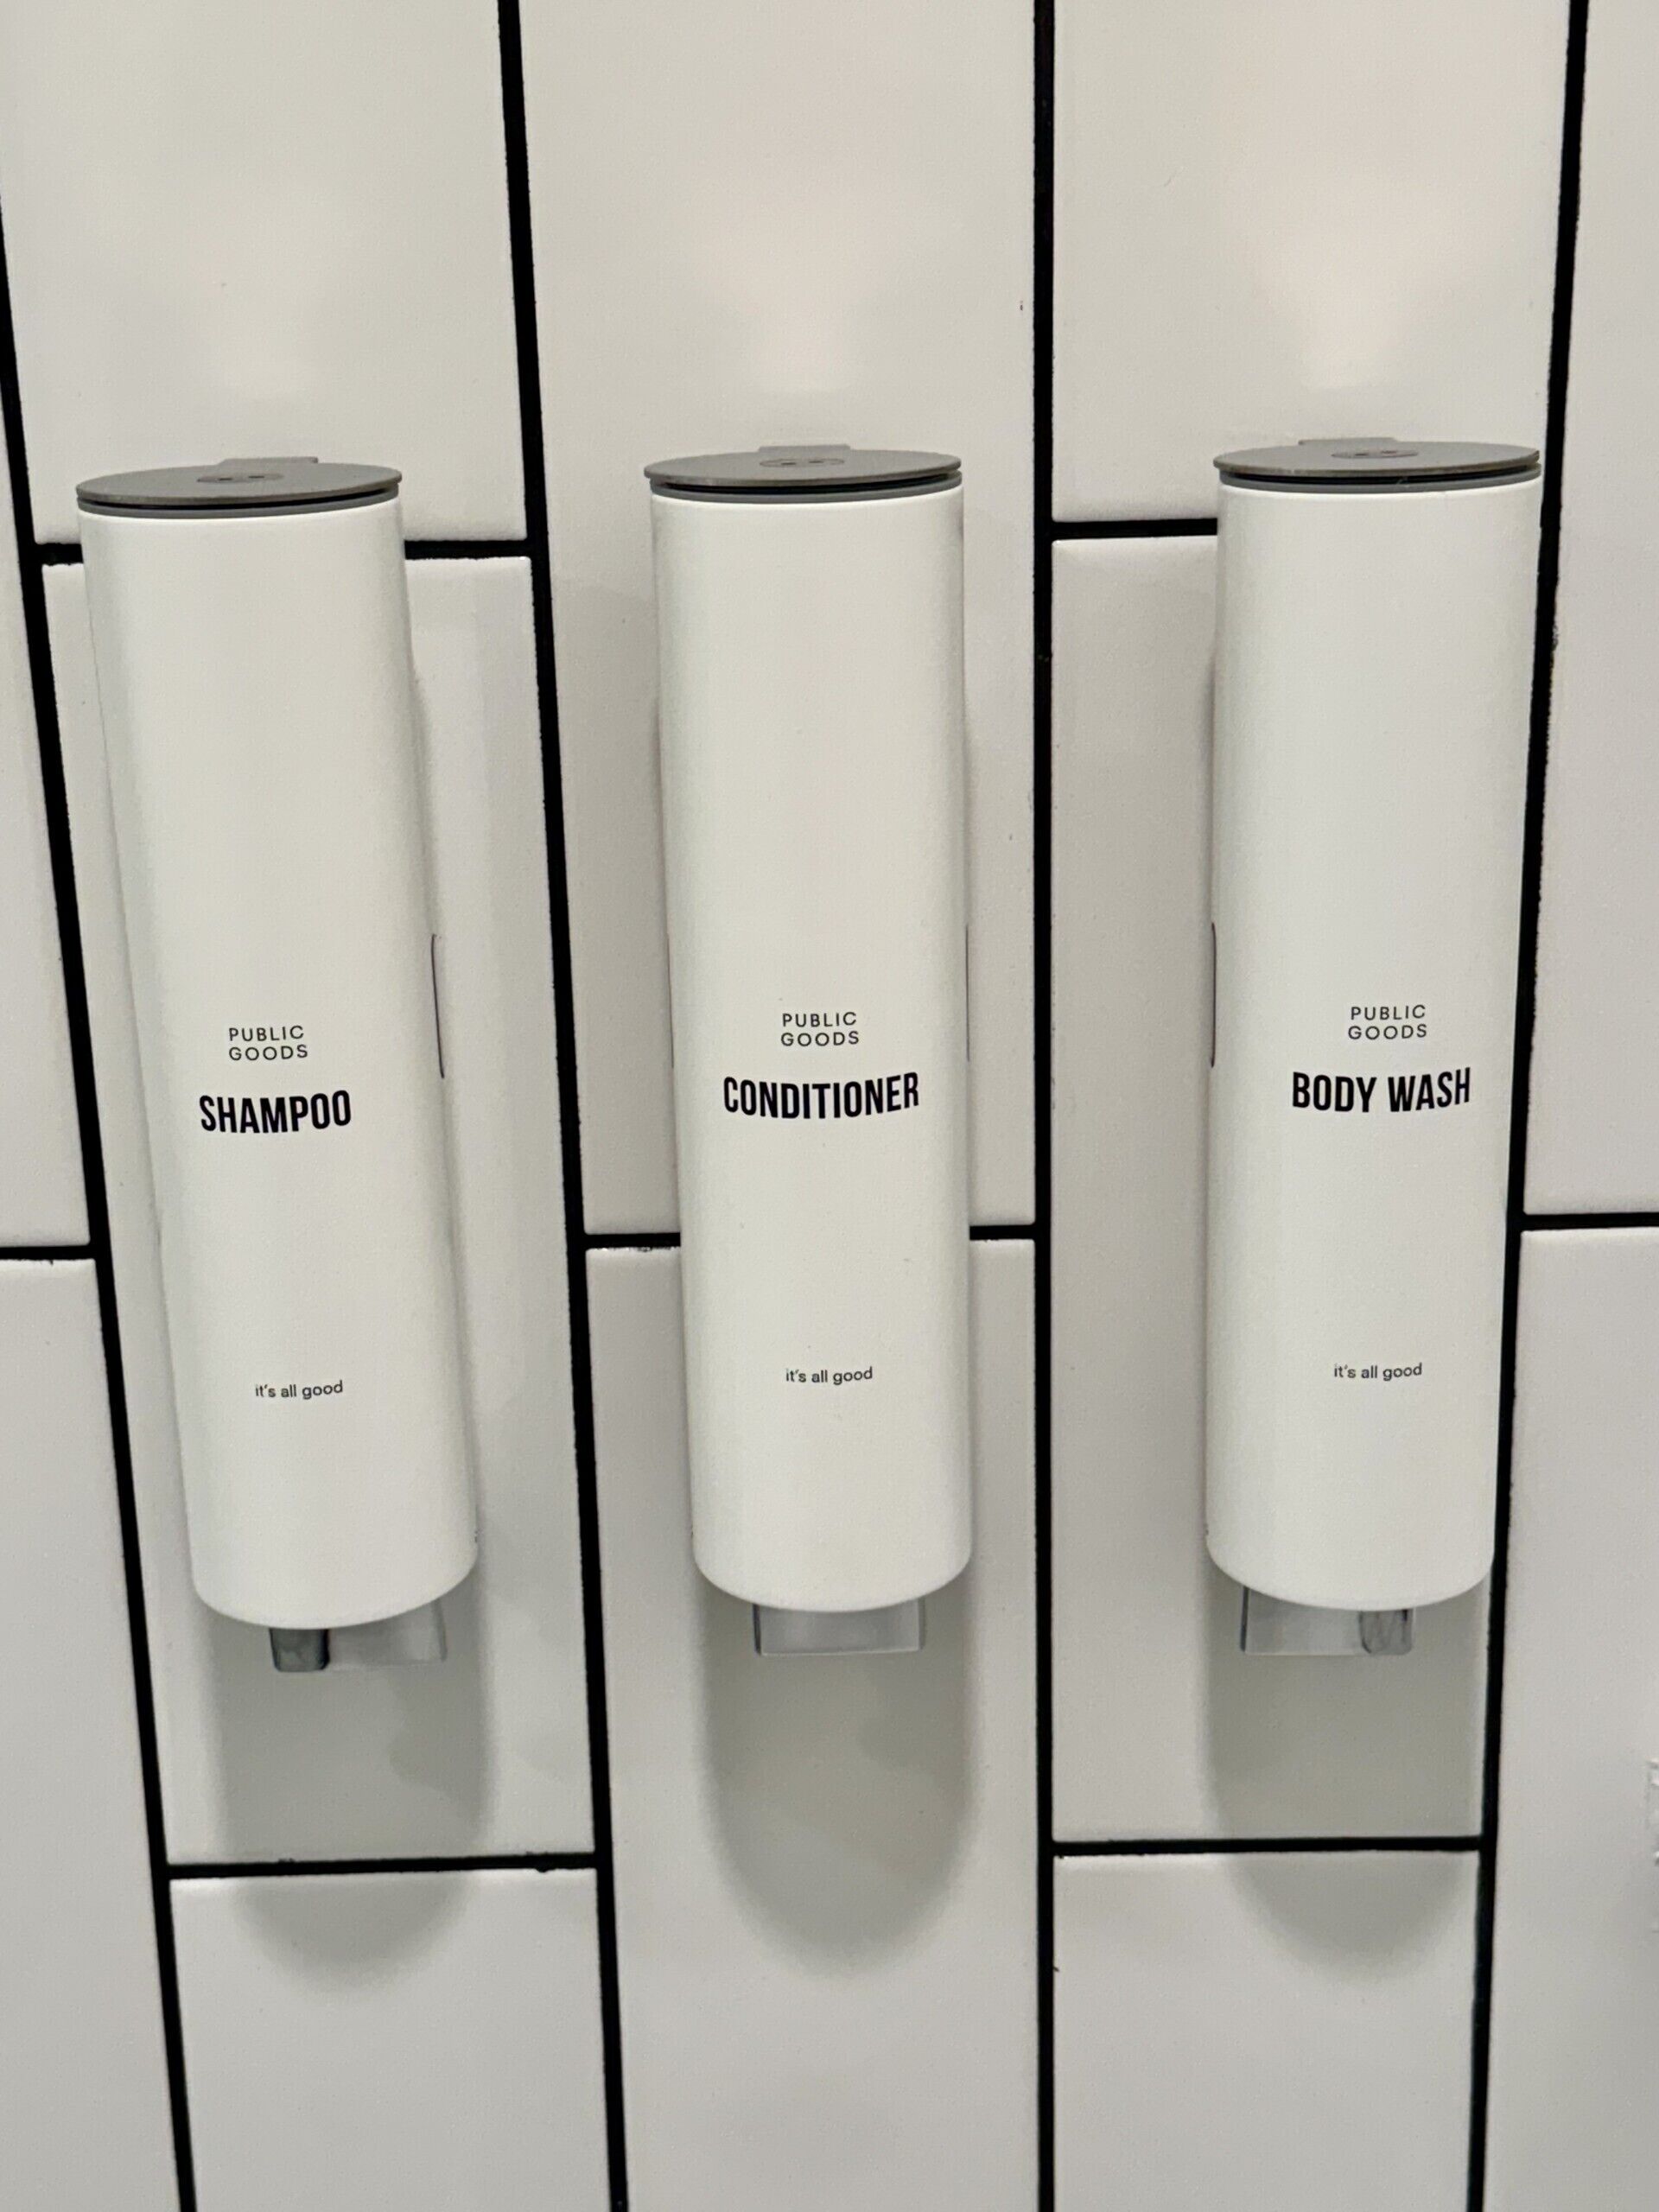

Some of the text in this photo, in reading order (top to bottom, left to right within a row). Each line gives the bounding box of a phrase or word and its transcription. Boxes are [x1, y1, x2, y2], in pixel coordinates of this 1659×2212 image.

[782, 1011, 857, 1028] PUBLIC
[1351, 1003, 1426, 1021] PUBLIC
[228, 1024, 305, 1042] PUBLIC
[780, 1030, 860, 1047] GOODS
[1347, 1023, 1427, 1041] GOODS
[228, 1043, 308, 1062] GOODS
[722, 1071, 920, 1120] CONDITIONER
[1292, 1066, 1471, 1114] BODY WASH
[199, 1089, 352, 1135] SHAMPOO
[785, 1365, 874, 1386] it's all good
[1333, 1361, 1423, 1382] it's all good
[255, 1379, 344, 1401] it's all good
